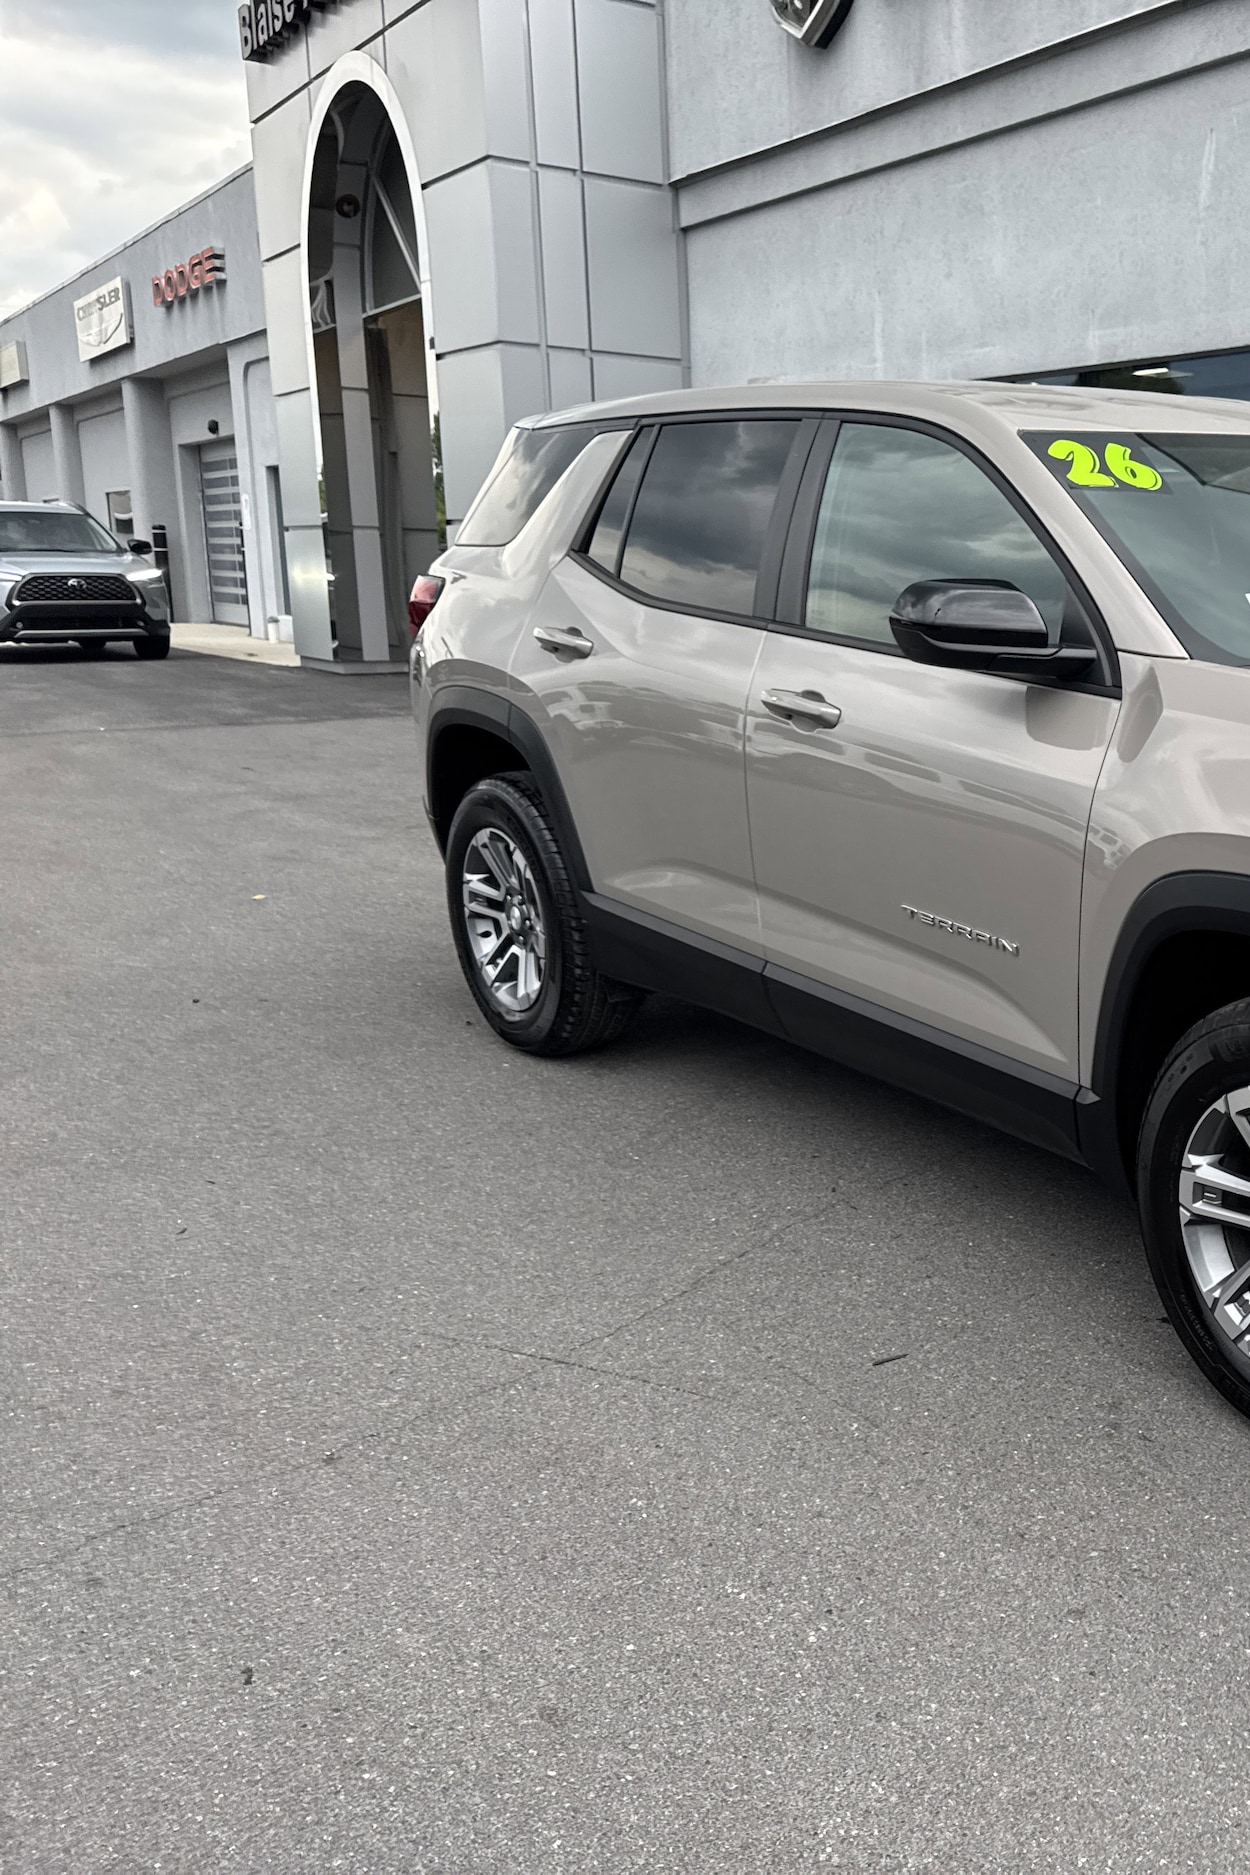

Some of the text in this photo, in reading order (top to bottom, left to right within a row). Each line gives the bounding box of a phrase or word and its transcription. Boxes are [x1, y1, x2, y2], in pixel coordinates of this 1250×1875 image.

[151, 246, 219, 308] DODGE
[1047, 439, 1163, 491] 26
[900, 904, 1020, 958] TERRAIN
